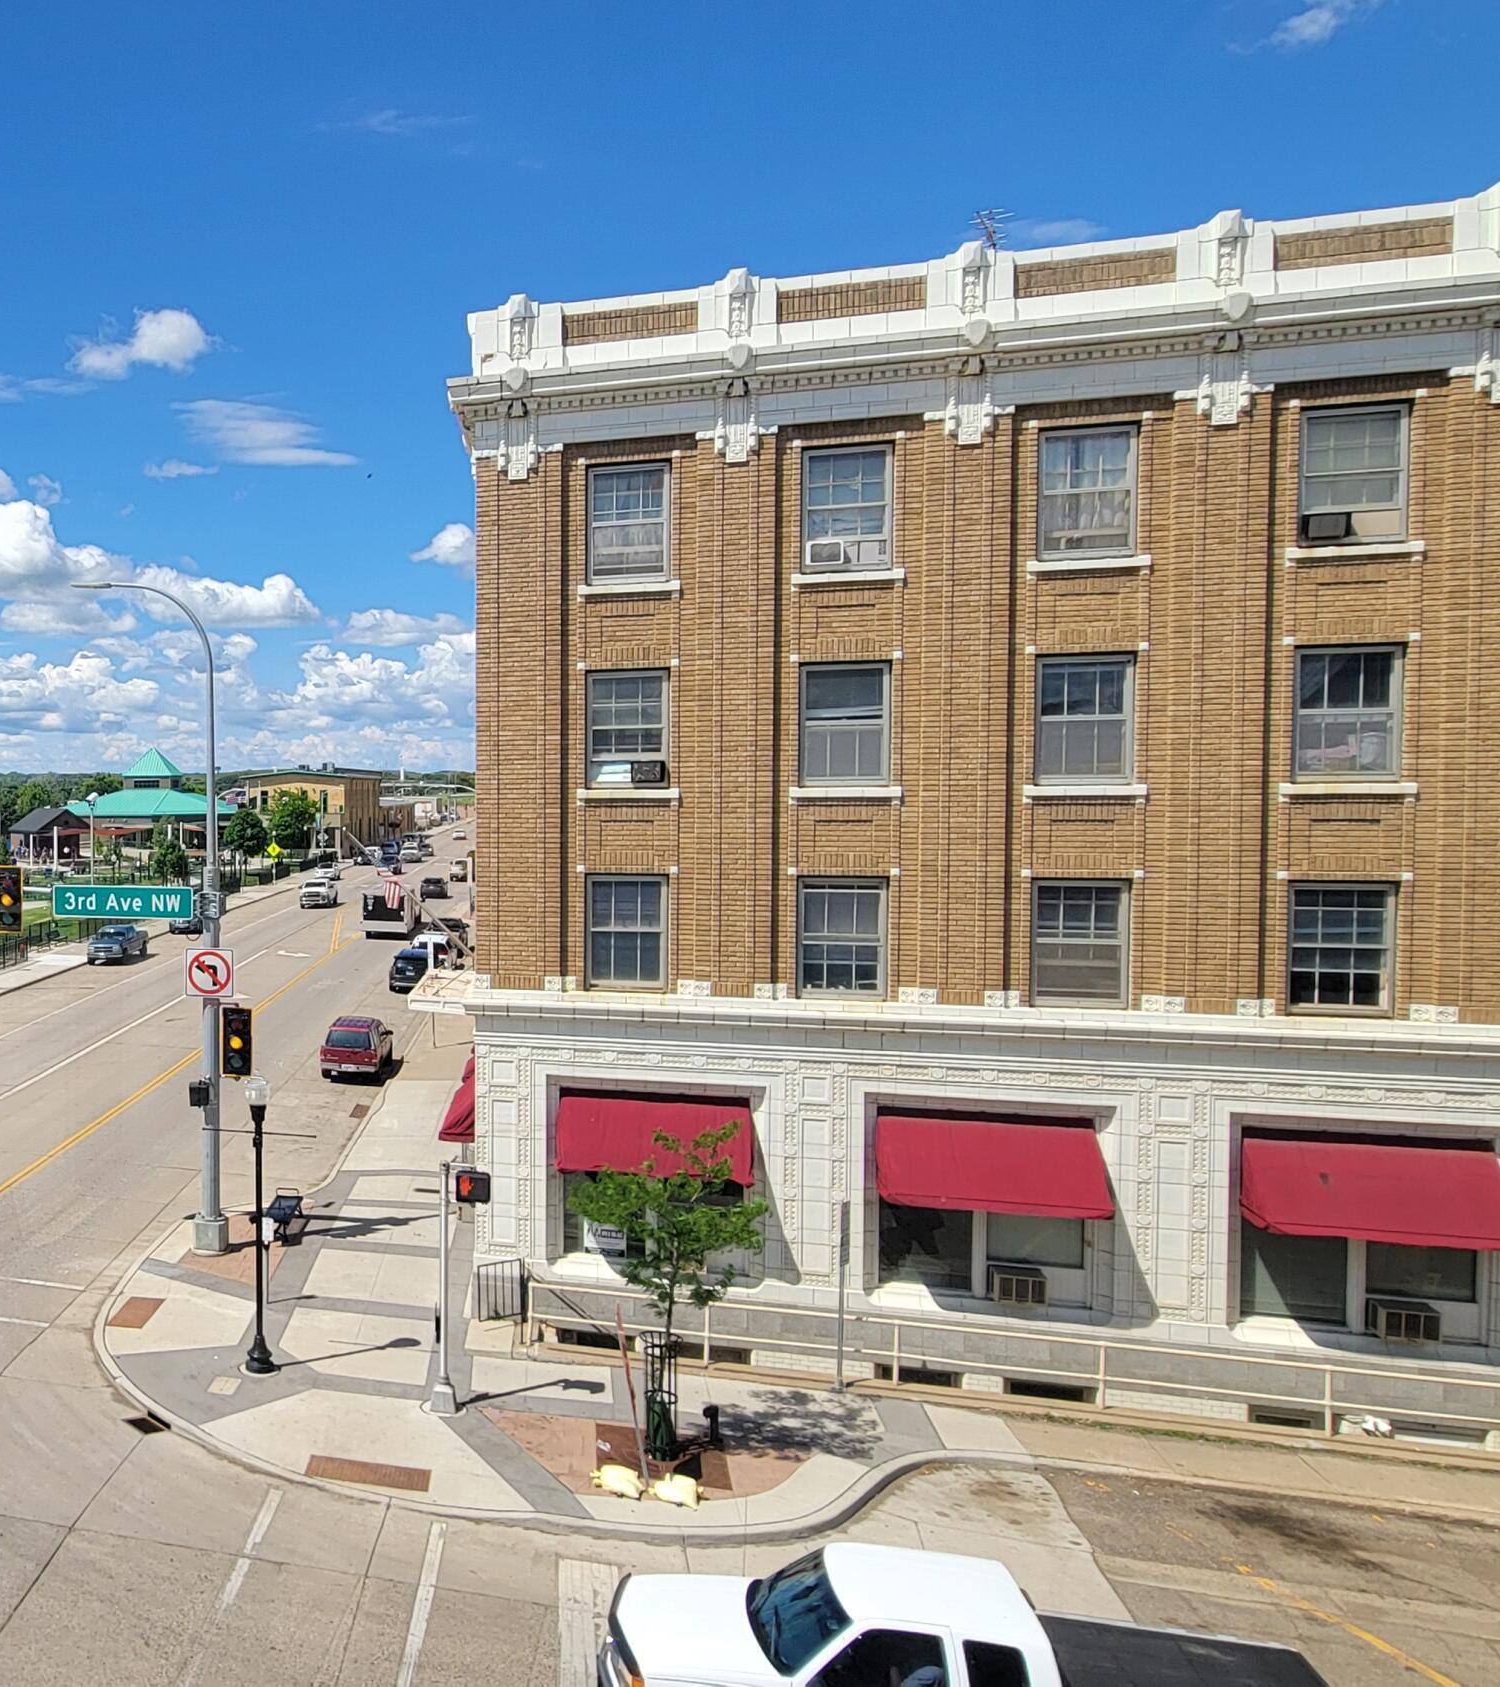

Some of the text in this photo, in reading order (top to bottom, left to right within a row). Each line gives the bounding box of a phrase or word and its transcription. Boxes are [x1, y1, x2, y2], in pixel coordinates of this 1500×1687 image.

[64, 892, 181, 913] 3rd Ave NW
